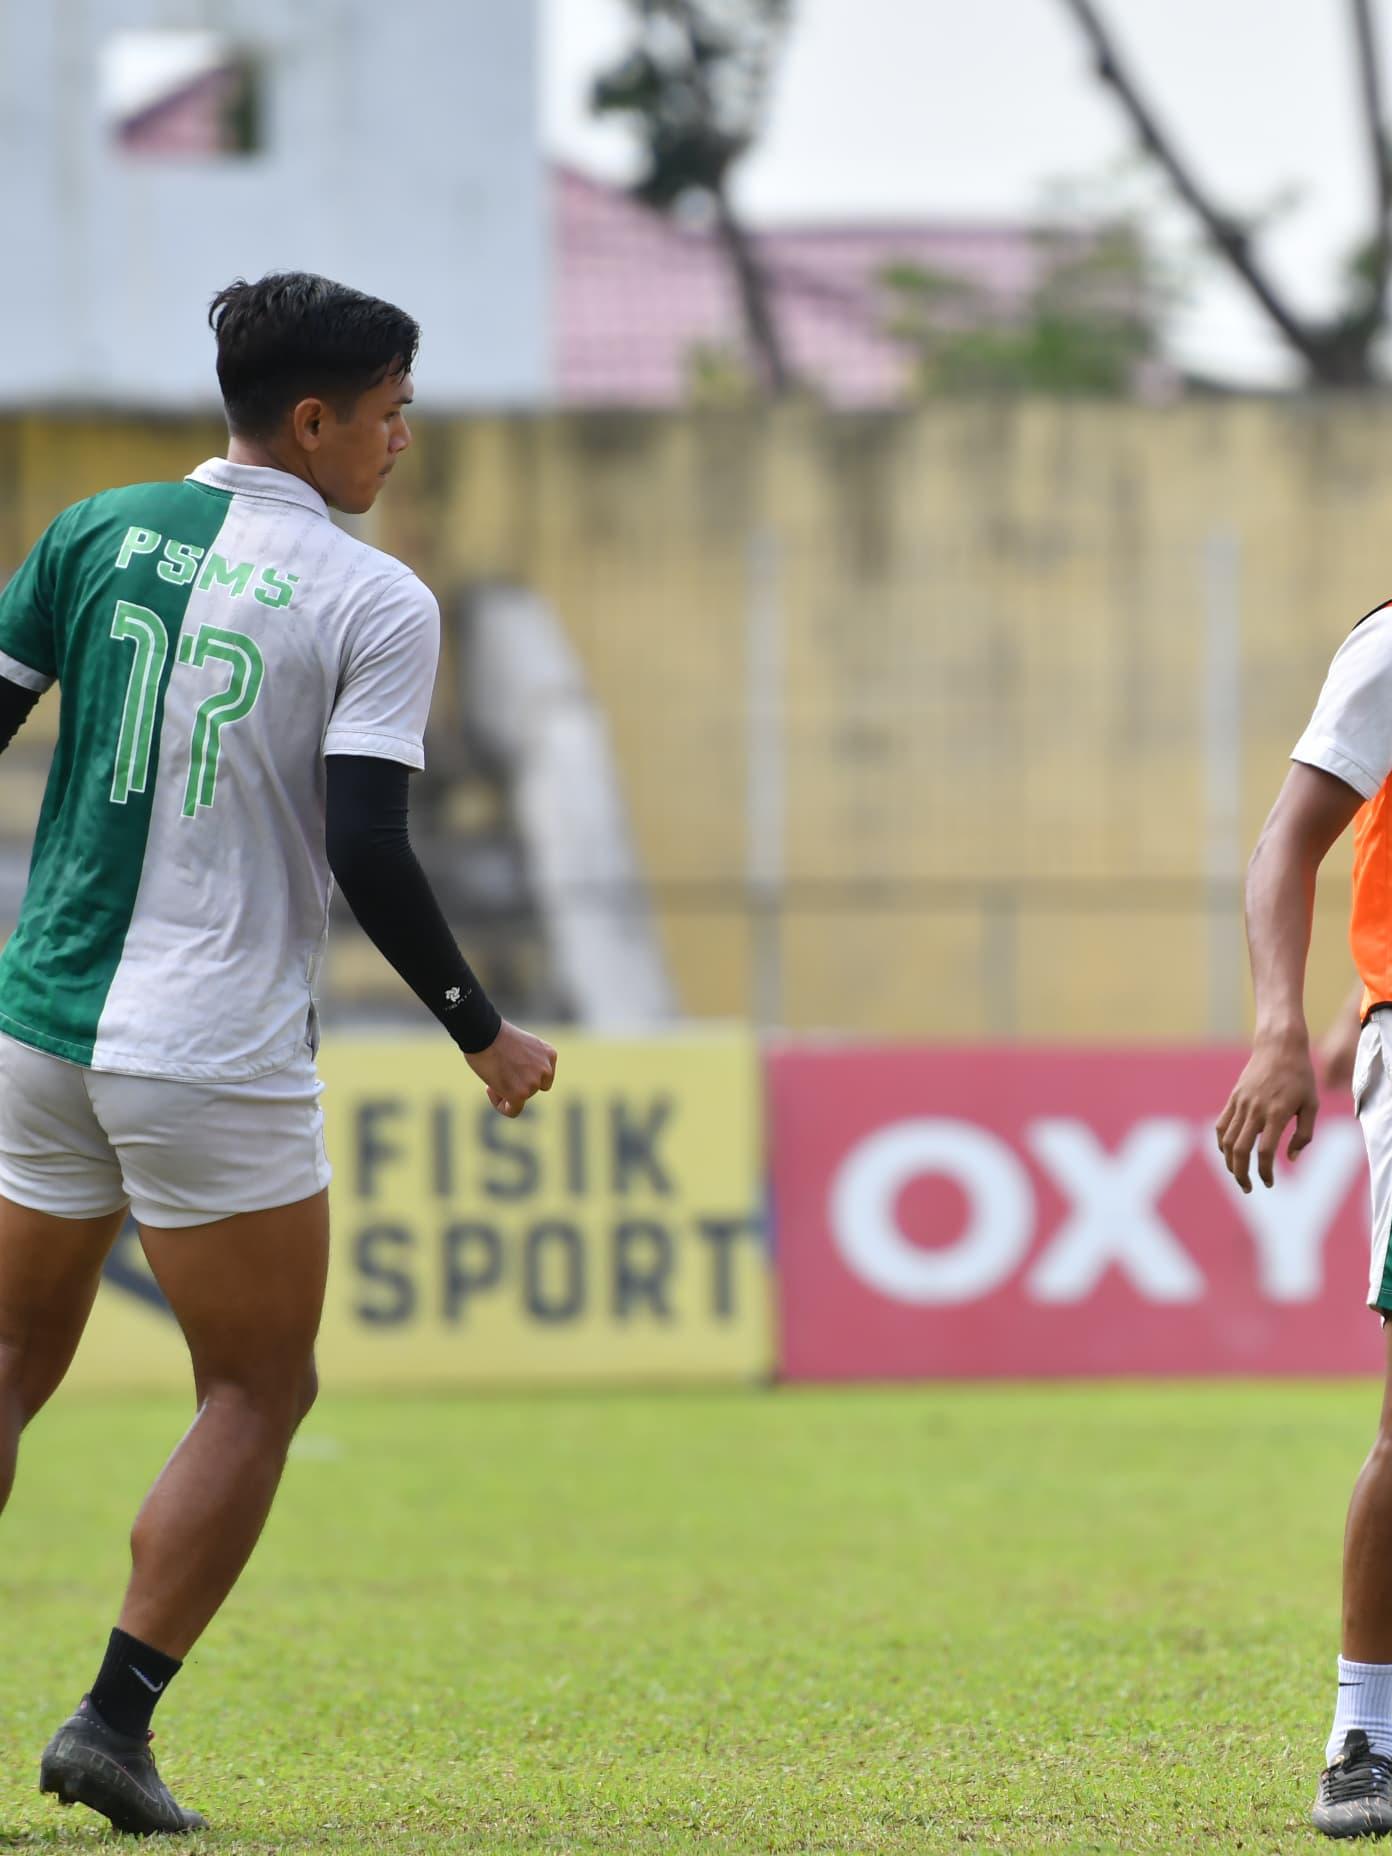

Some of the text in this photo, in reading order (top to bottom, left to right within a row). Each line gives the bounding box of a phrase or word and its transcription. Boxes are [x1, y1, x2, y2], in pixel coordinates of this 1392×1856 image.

[115, 526, 300, 610] PSMS
[110, 601, 265, 818] 17
[354, 1096, 676, 1202] FISIK
[354, 1218, 762, 1326] SPORT
